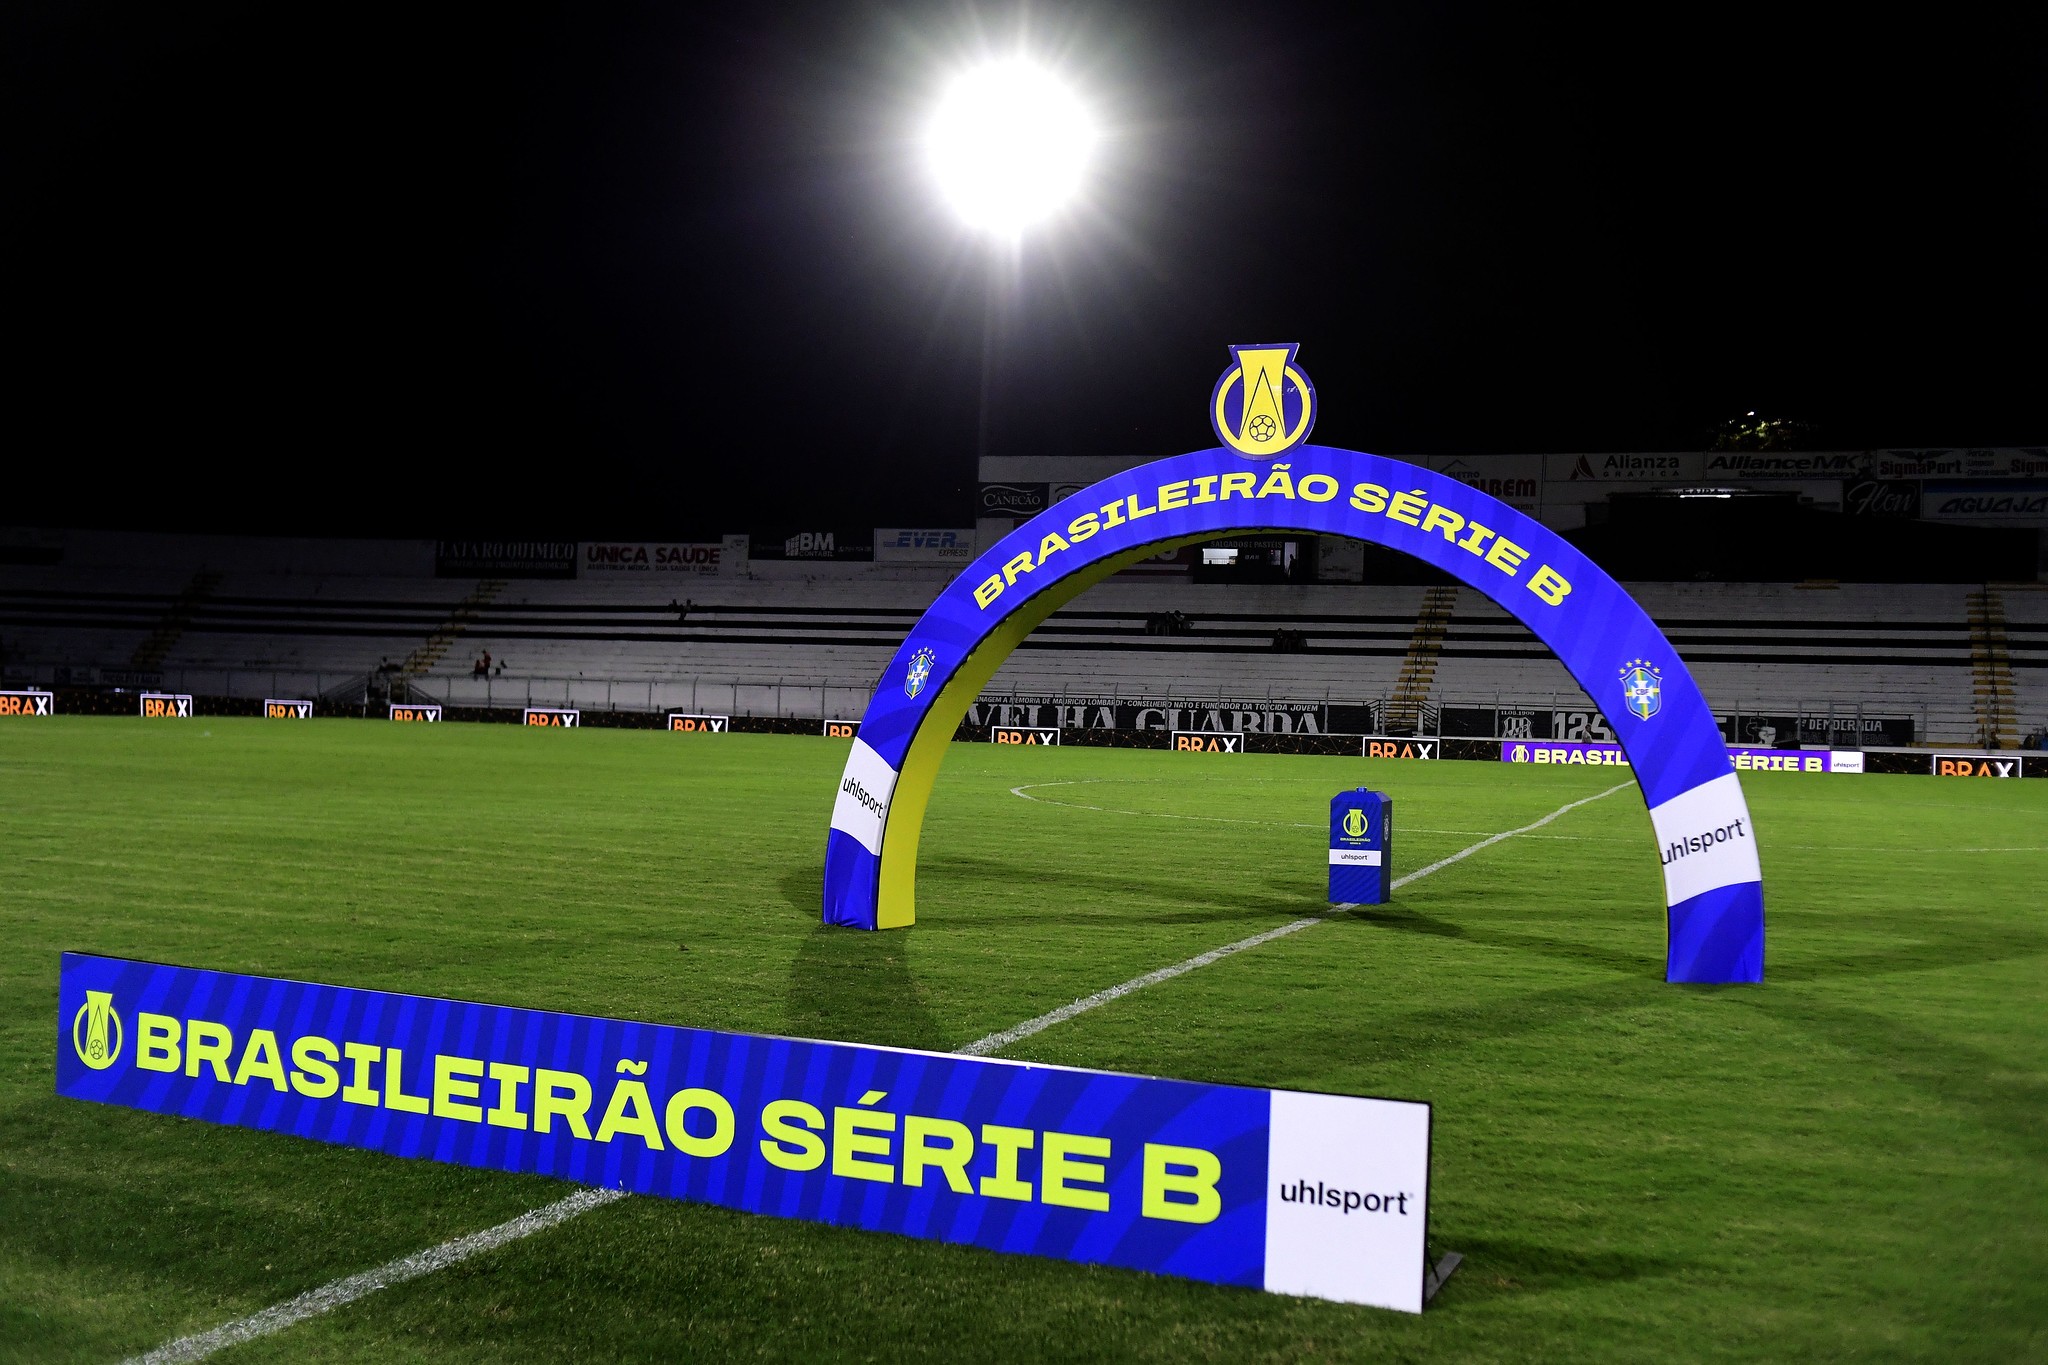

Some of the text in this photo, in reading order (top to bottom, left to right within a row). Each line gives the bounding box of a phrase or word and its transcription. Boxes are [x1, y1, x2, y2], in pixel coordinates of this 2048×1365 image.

[1604, 454, 1680, 469] Alianza
[1879, 459, 1962, 479] SigmaPort
[800, 532, 835, 551] BM
[896, 532, 957, 548] EVER
[973, 464, 1572, 611] BRASILEIRÃO SÉRIE B
[587, 544, 721, 565] ÚNICA SAÚDE
[938, 549, 969, 557] EXPRESS
[1635, 688, 1649, 696] CBF
[0, 696, 48, 716] BRAX
[145, 700, 187, 718] BRAX
[975, 696, 1002, 704] ENAGEM
[1042, 697, 1051, 705] DE
[1290, 704, 1319, 712] JOVEM
[1135, 708, 1320, 733] GUARDA
[1369, 742, 1433, 760] BRAX
[1534, 748, 1629, 766] BRASIL
[1805, 757, 1822, 772] B
[1833, 761, 1859, 769] uhlsport
[1941, 760, 2013, 778] BRAX
[843, 777, 884, 820] uhlsport
[1660, 818, 1745, 866] uhlsport
[136, 1013, 1222, 1225] BRASILEIRÃO SÉRIE B
[1281, 1179, 1408, 1216] uhlsport
